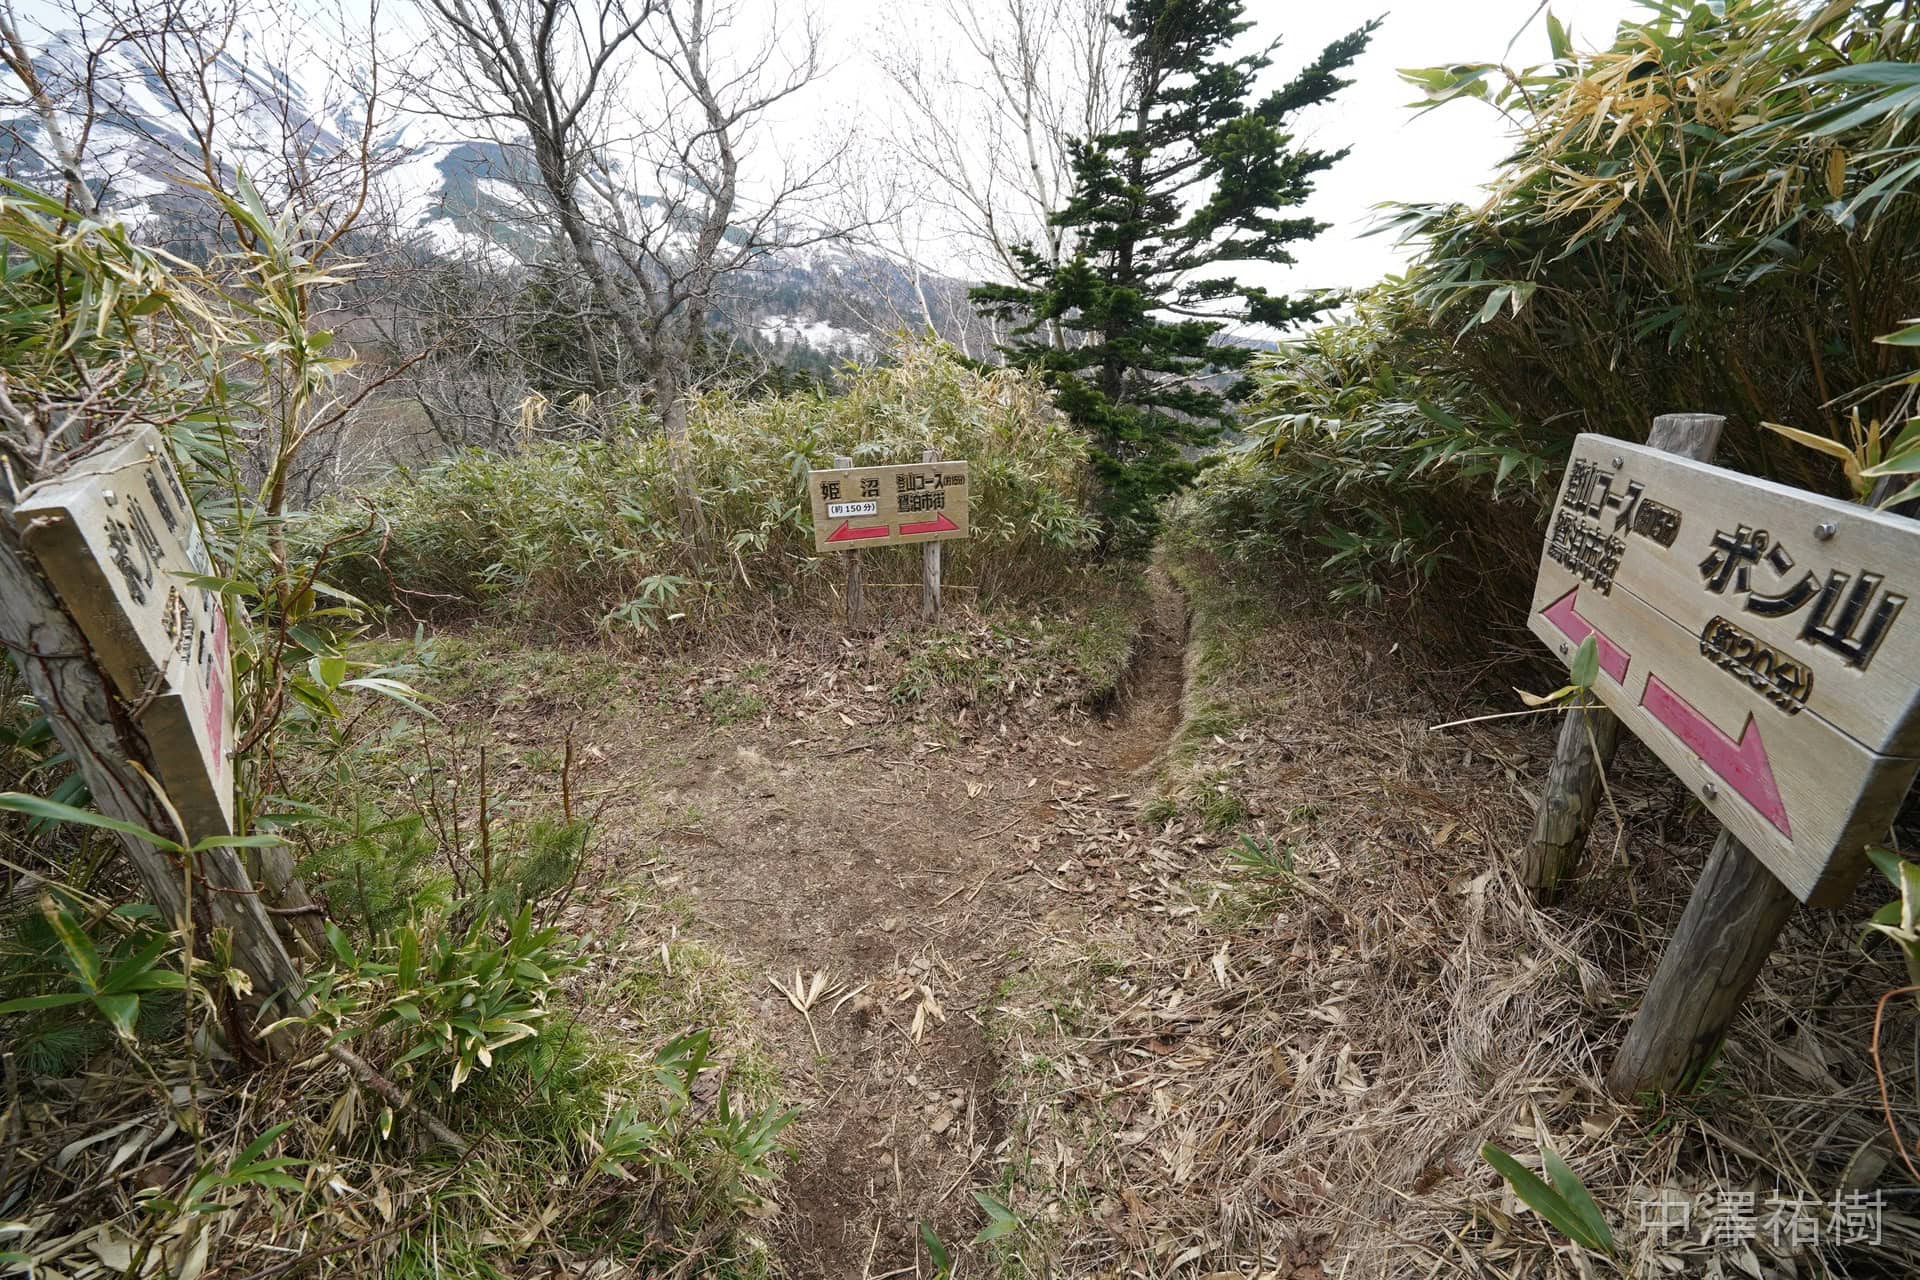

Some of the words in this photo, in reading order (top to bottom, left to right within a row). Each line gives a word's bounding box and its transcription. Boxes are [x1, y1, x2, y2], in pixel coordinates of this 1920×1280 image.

[831, 503, 875, 513] (約150分)
[896, 472, 944, 492] 登山コース
[1563, 458, 1645, 537] 登山コース
[1698, 523, 1907, 672] ポン山
[1701, 616, 1814, 717] (約20分)
